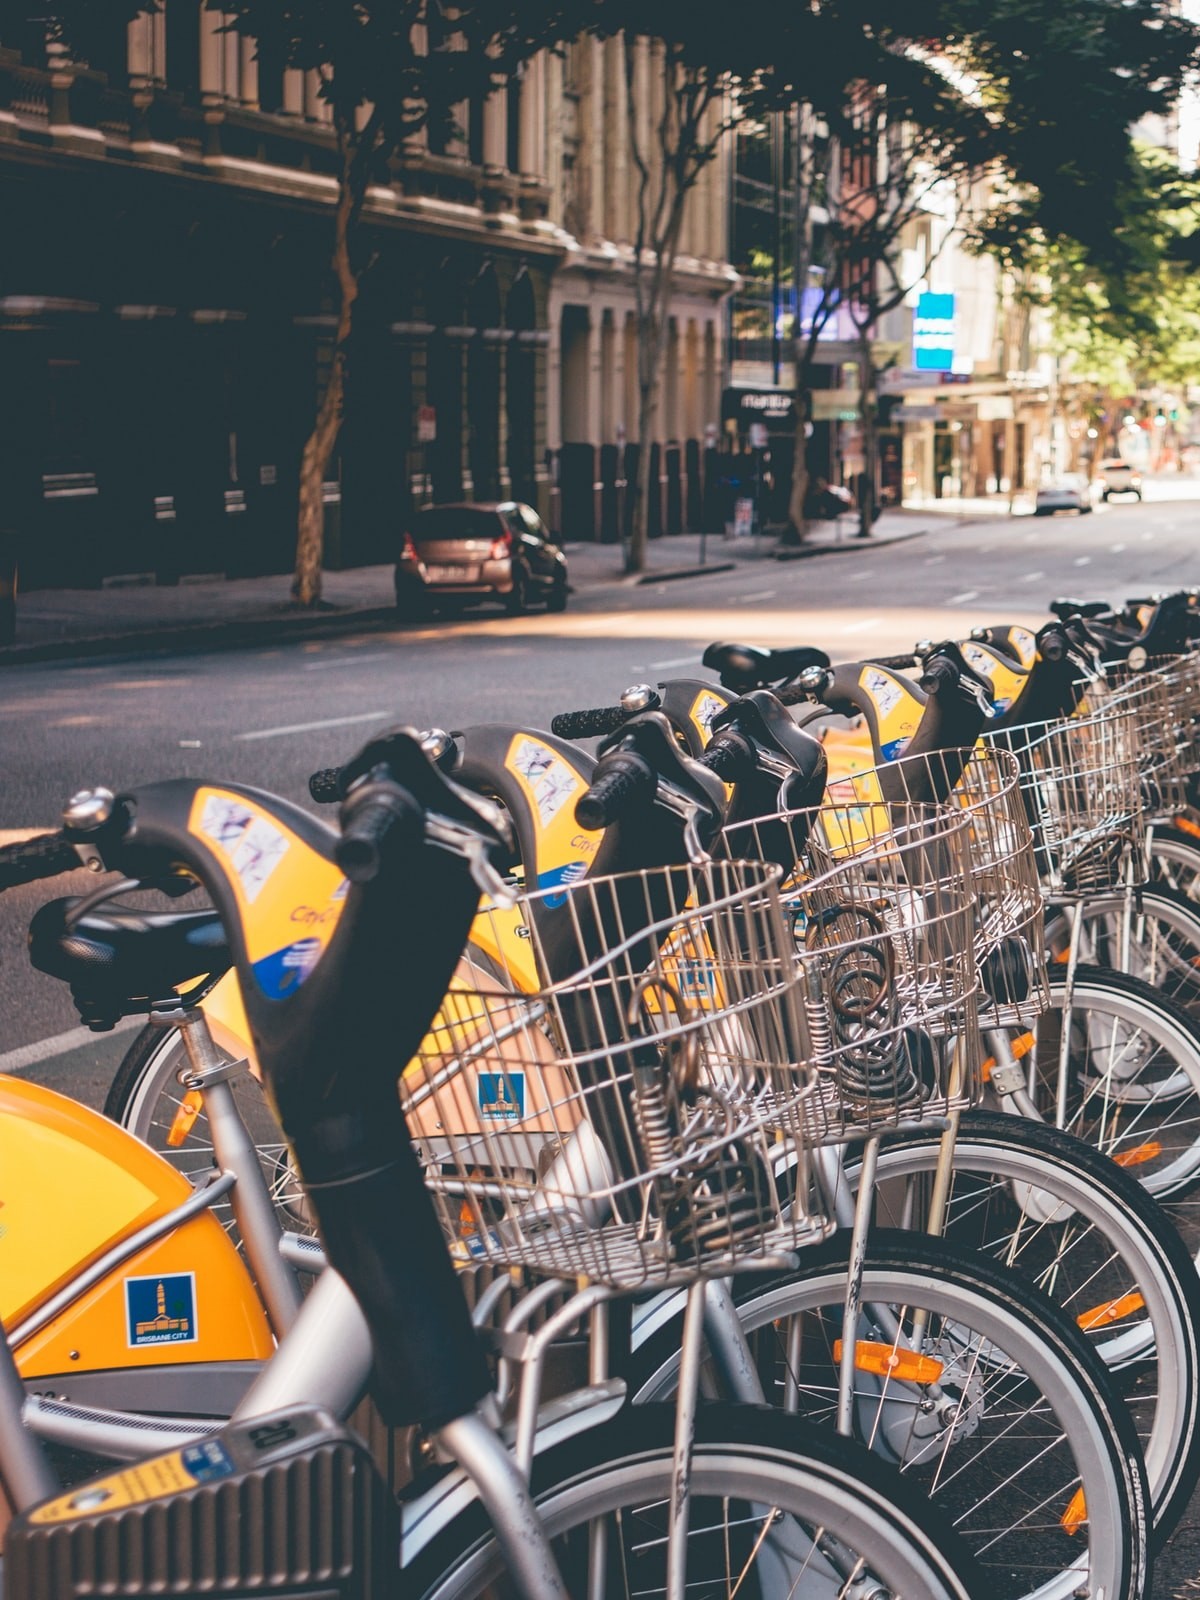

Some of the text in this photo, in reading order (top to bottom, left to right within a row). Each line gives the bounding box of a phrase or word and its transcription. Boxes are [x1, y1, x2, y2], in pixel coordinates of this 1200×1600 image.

[136, 1332, 188, 1343] BRISBANE CITY
[1128, 1456, 1147, 1541] SCHWALBE
